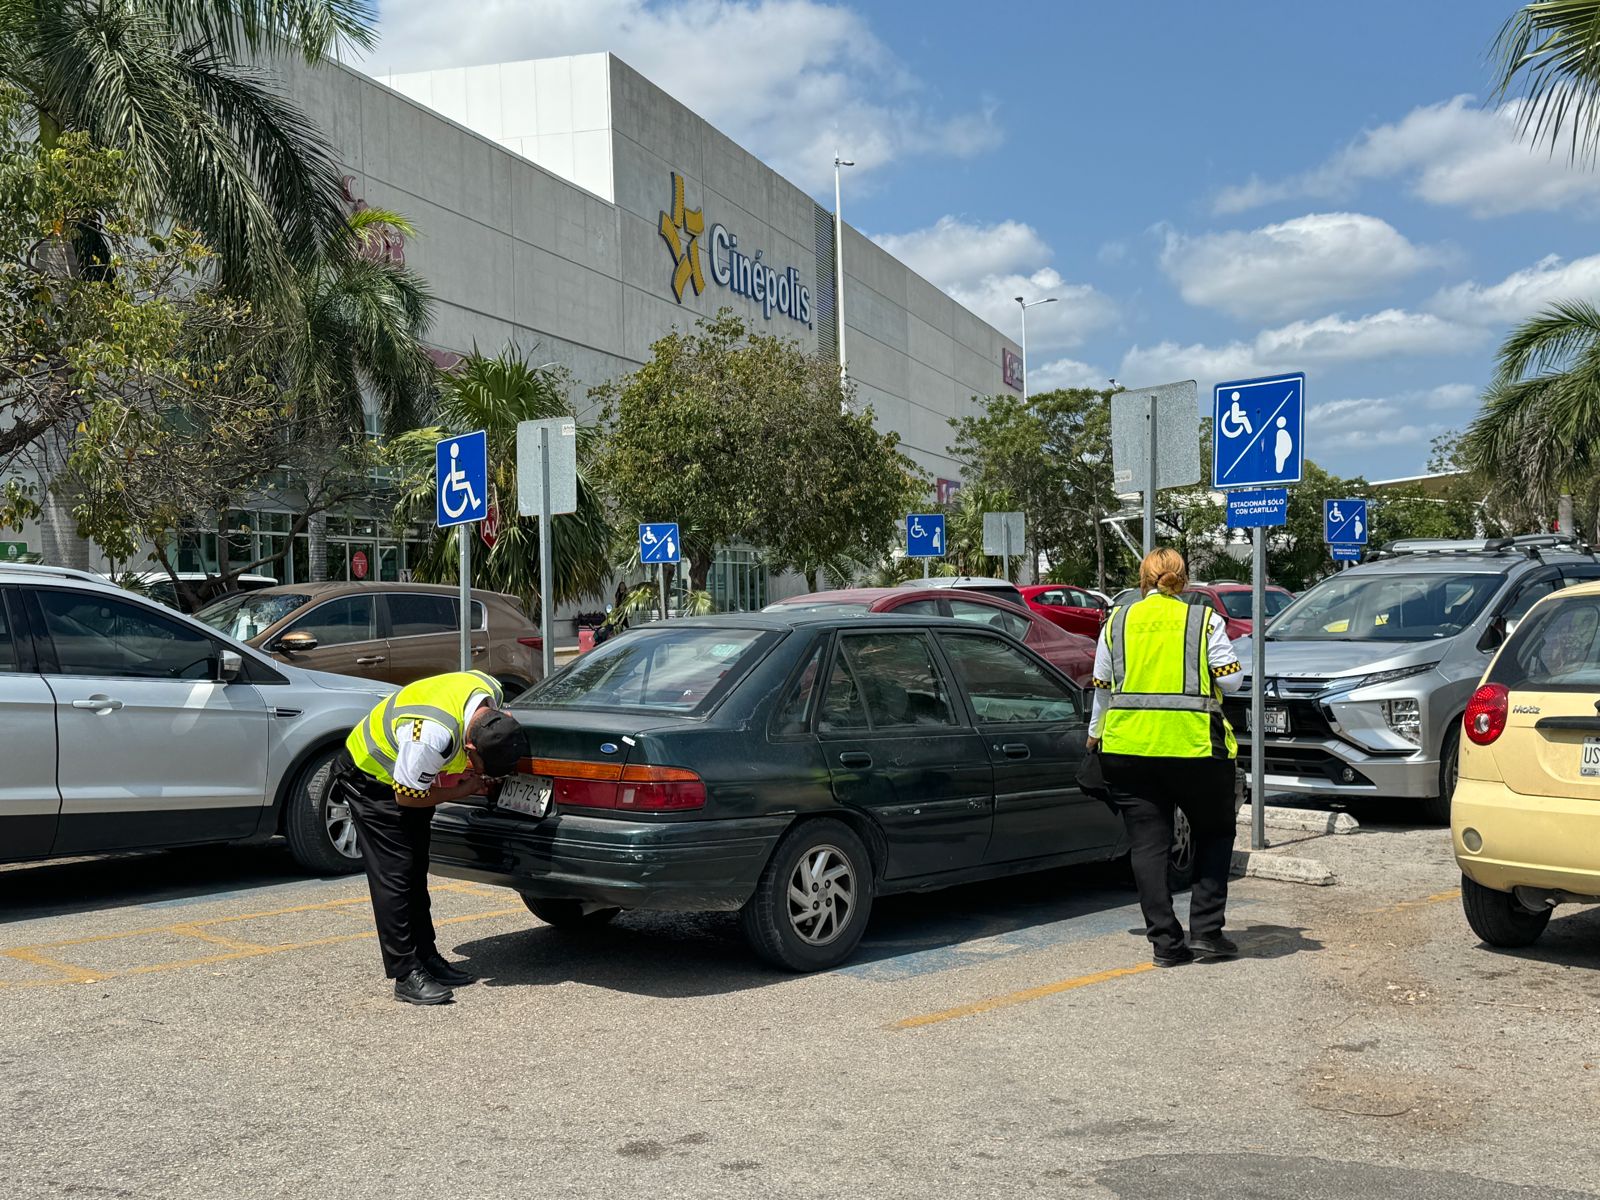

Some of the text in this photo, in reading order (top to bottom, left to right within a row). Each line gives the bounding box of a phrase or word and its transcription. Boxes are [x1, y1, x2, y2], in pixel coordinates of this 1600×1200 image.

[709, 223, 811, 323] Cinépolis
[1230, 500, 1266, 508] ESTACIONAR
[1249, 506, 1278, 514] CARTILLA
